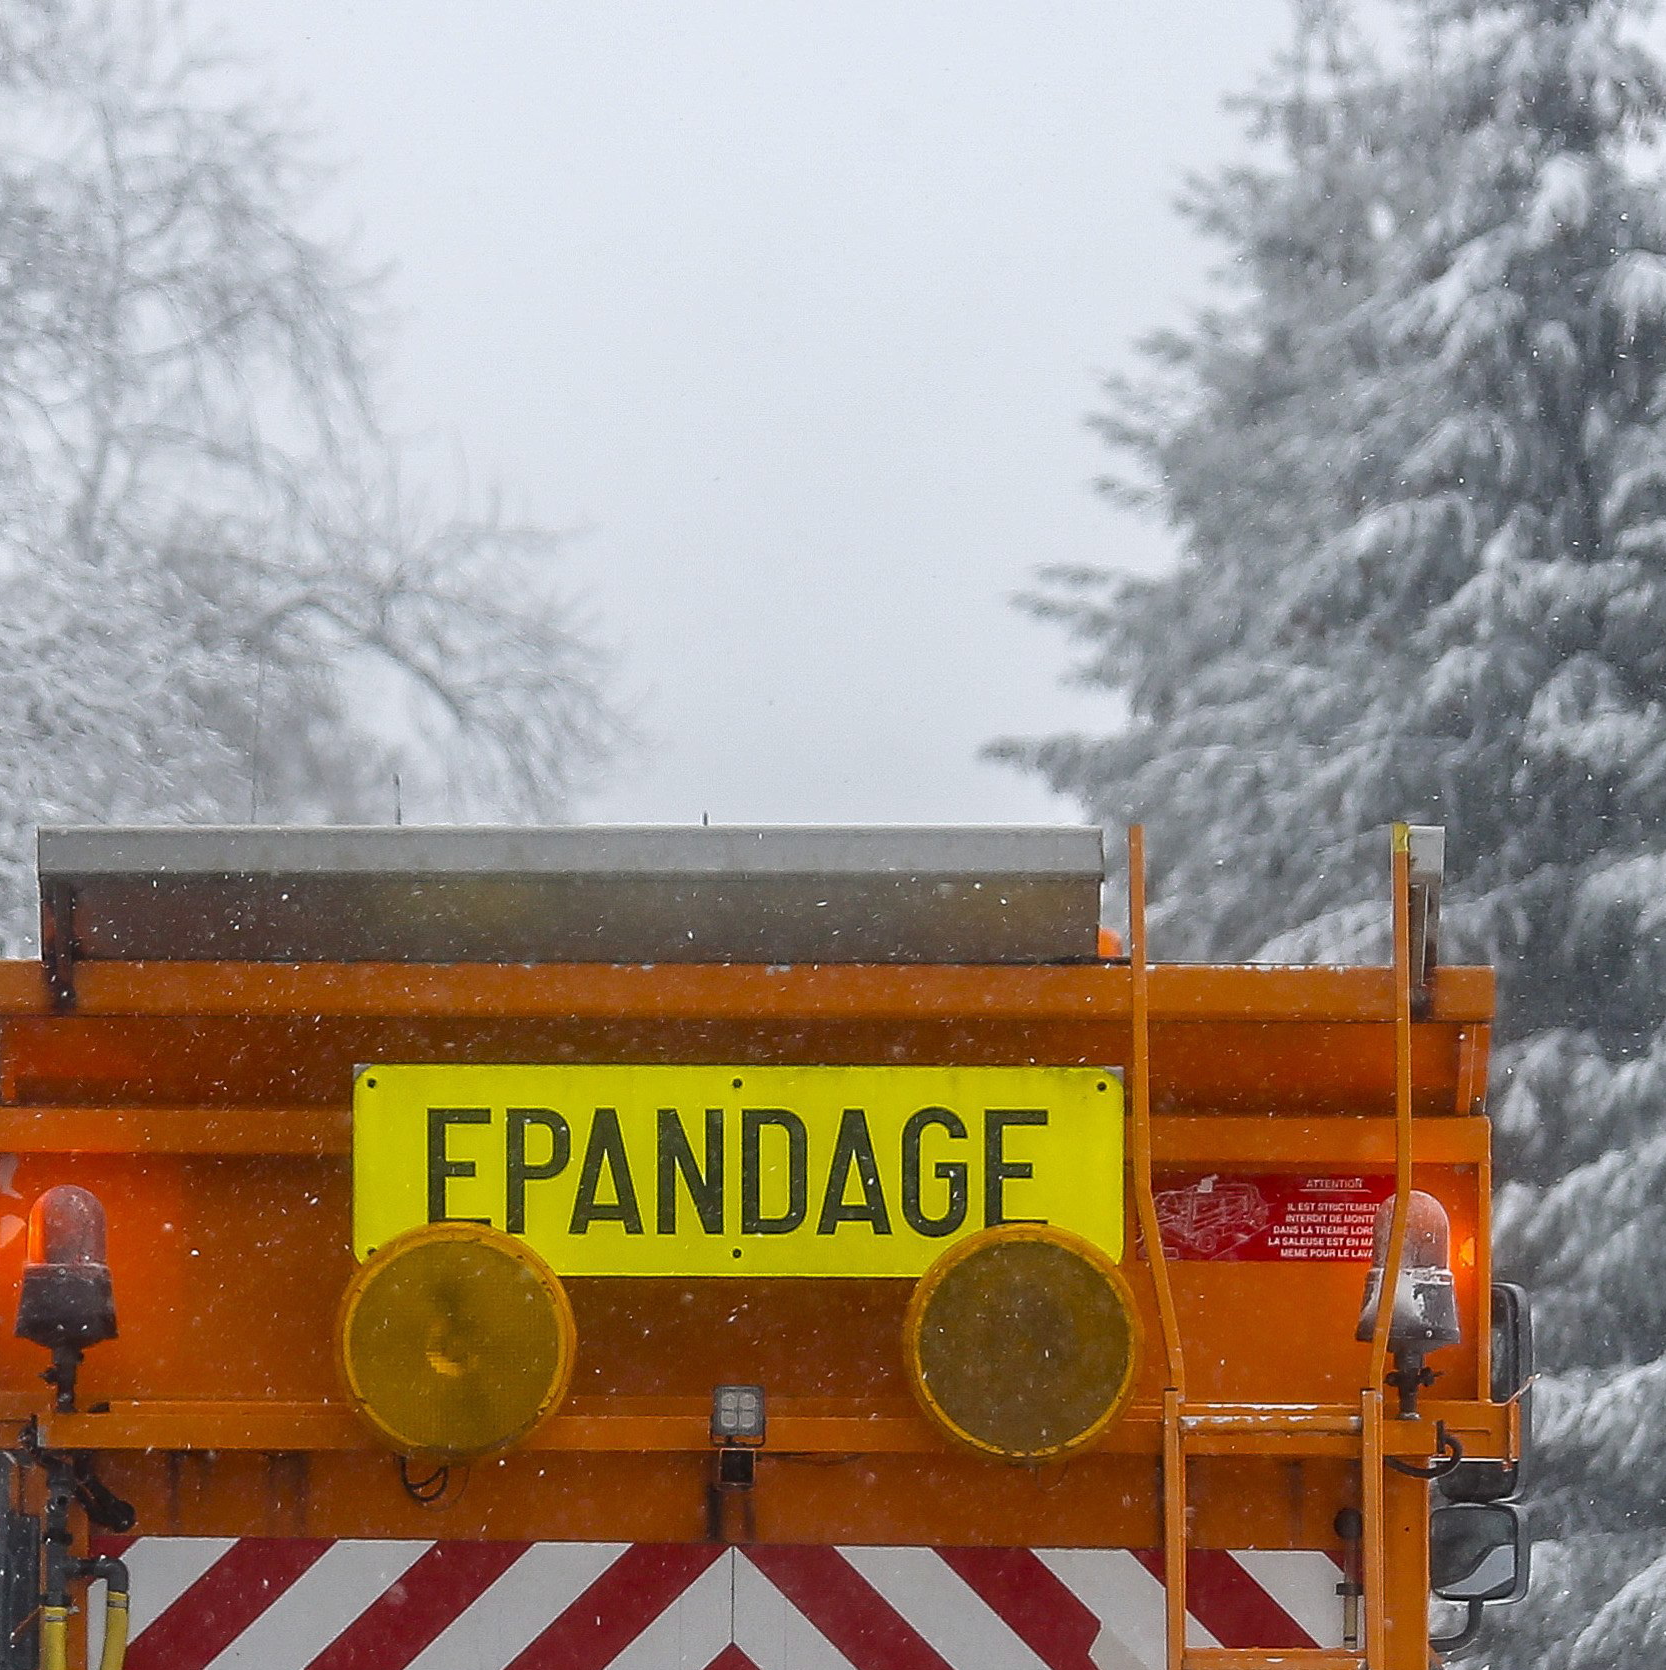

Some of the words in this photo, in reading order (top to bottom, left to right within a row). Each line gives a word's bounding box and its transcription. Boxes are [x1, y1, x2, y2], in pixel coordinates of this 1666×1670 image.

[426, 1107, 1048, 1237] EPANDAGE
[1306, 1178, 1363, 1188] ATTENTION
[1287, 1203, 1296, 1211] IL
[1298, 1203, 1315, 1211] EST
[1317, 1203, 1380, 1212] STRICTEMENT
[1286, 1214, 1327, 1222] INTERDIT
[1329, 1214, 1342, 1222] DE
[1273, 1226, 1299, 1234] DANS
[1301, 1226, 1313, 1234] LA
[1268, 1237, 1280, 1245] LA
[1282, 1237, 1324, 1246] SALEUSE
[1326, 1237, 1344, 1246] EST
[1346, 1237, 1359, 1246] EN
[1310, 1248, 1335, 1257] POUR
[1338, 1248, 1350, 1257] LE
